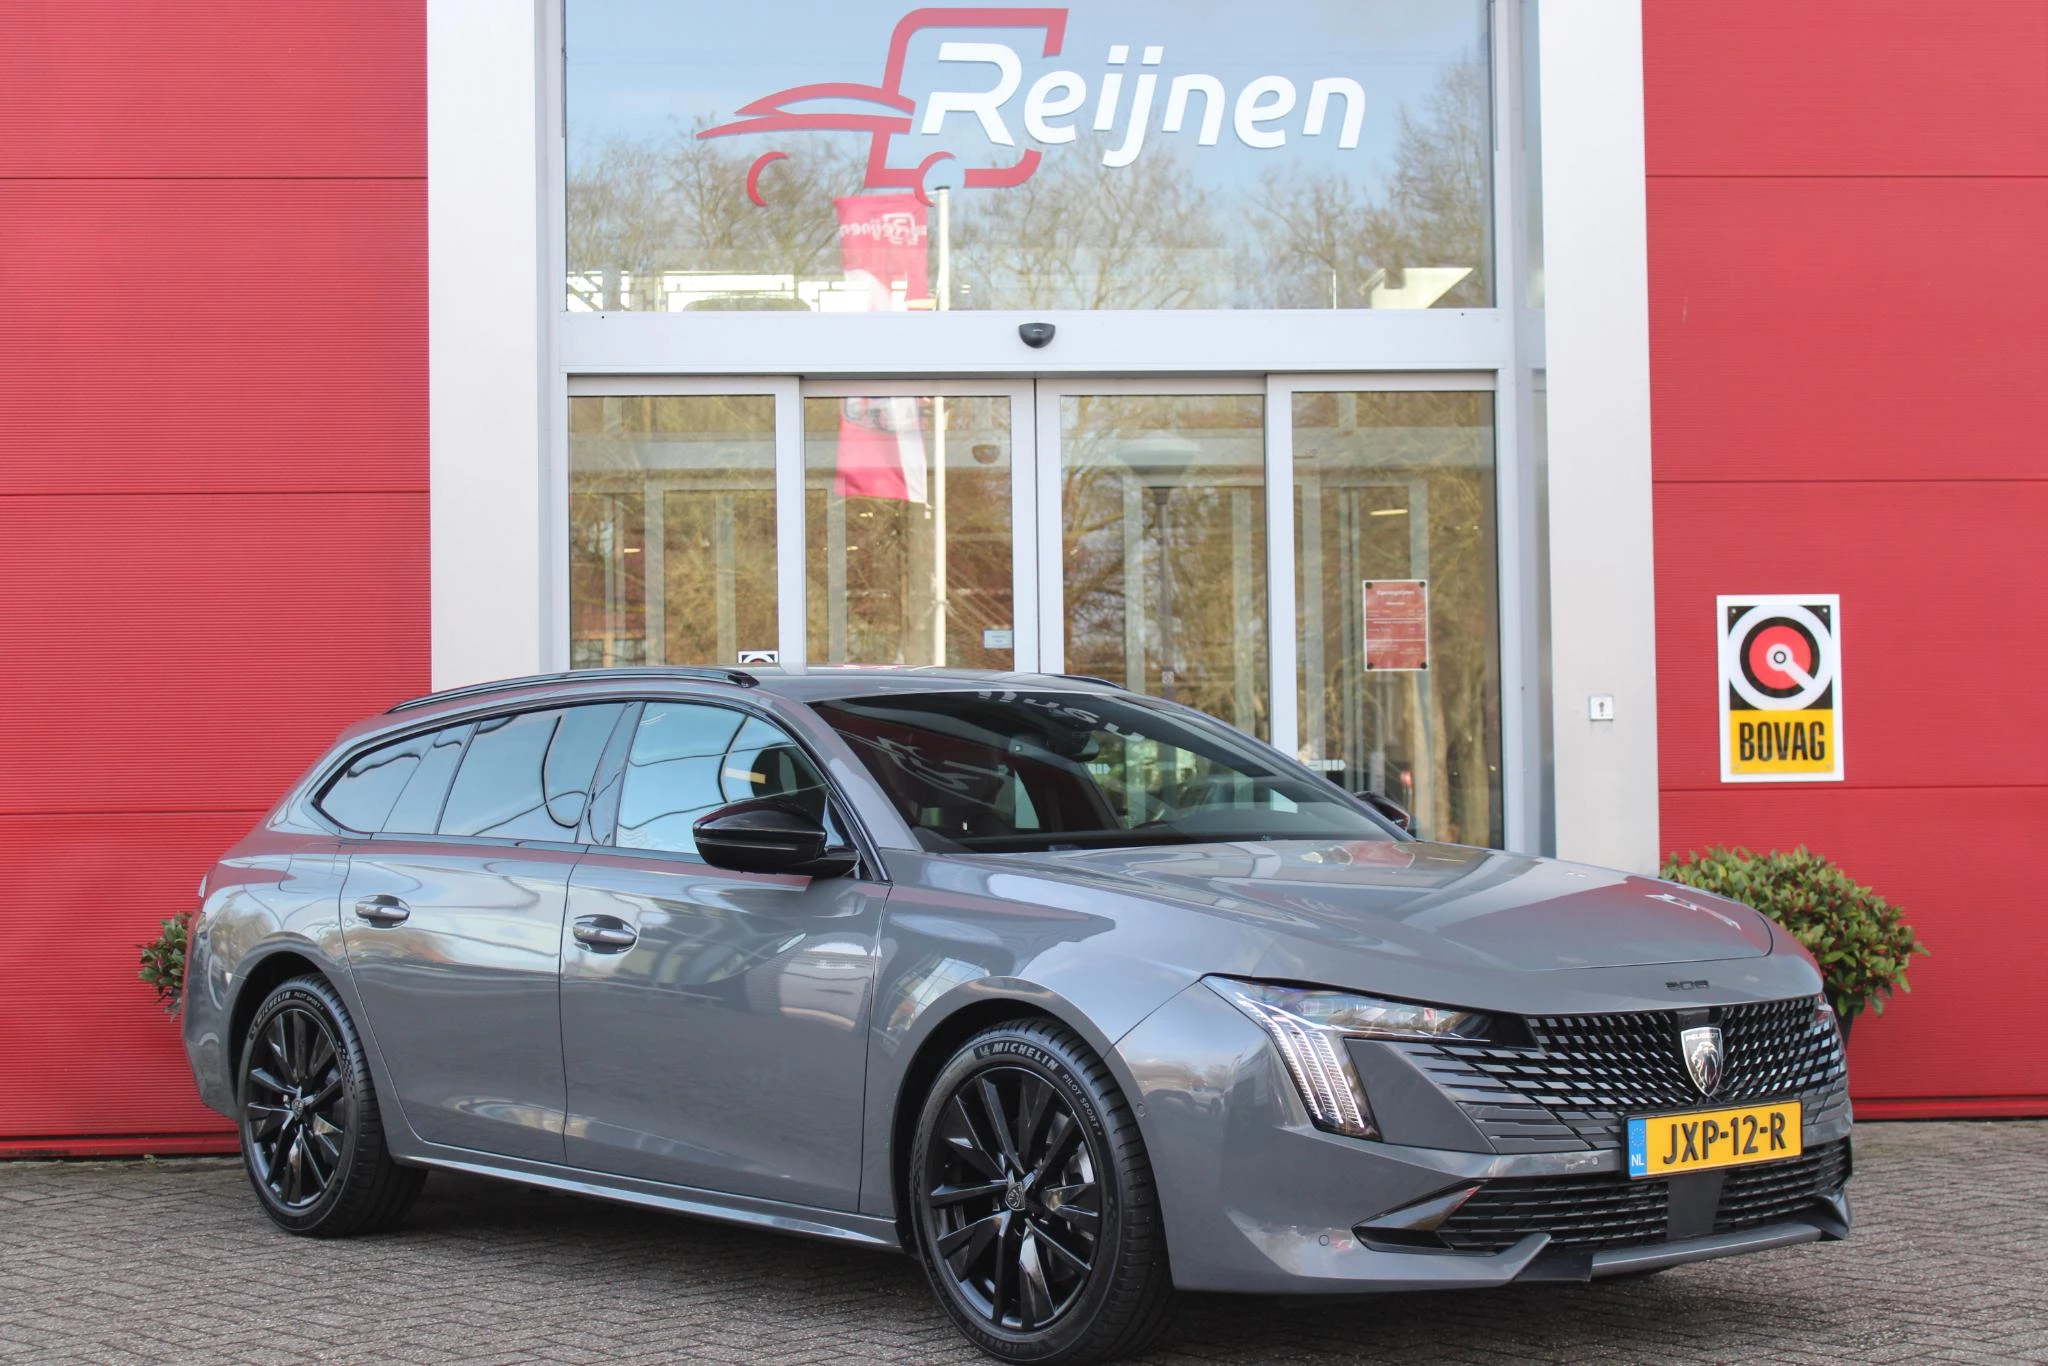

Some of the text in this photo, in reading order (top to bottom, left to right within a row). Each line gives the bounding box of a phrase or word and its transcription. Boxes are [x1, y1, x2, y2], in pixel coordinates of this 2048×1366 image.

[920, 41, 1366, 168] Reijnen
[1739, 721, 1825, 762] BOVAG
[992, 1042, 1058, 1071] MICHELIN
[1062, 1074, 1099, 1128] PILOT SPORT
[1631, 1154, 1645, 1167] NL
[1663, 1112, 1786, 1165] JXP-12-R
